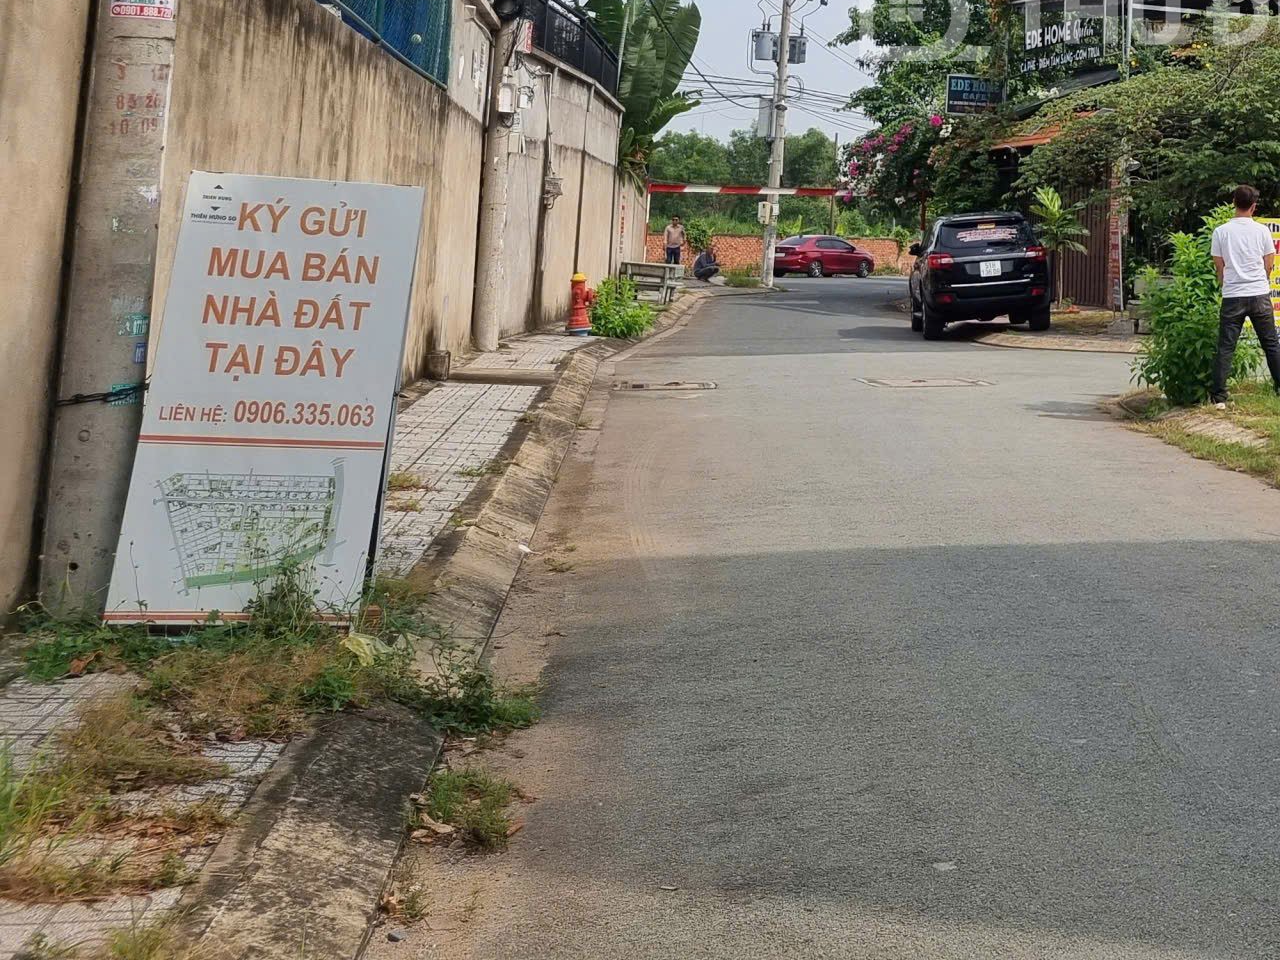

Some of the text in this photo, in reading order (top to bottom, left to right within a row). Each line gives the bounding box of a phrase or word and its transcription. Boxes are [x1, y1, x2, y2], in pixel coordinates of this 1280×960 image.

[1026, 28, 1043, 50] EDE
[1044, 20, 1071, 46] HOME
[951, 79, 971, 91] EDE
[237, 198, 368, 238] KÝ GỬI
[207, 247, 380, 284] MUA BÁN
[201, 290, 371, 331] NHÀ ĐẤT
[205, 340, 356, 381] TẠI ĐÂY
[159, 400, 375, 427] LIÊN HỆ: 0906.335.063
